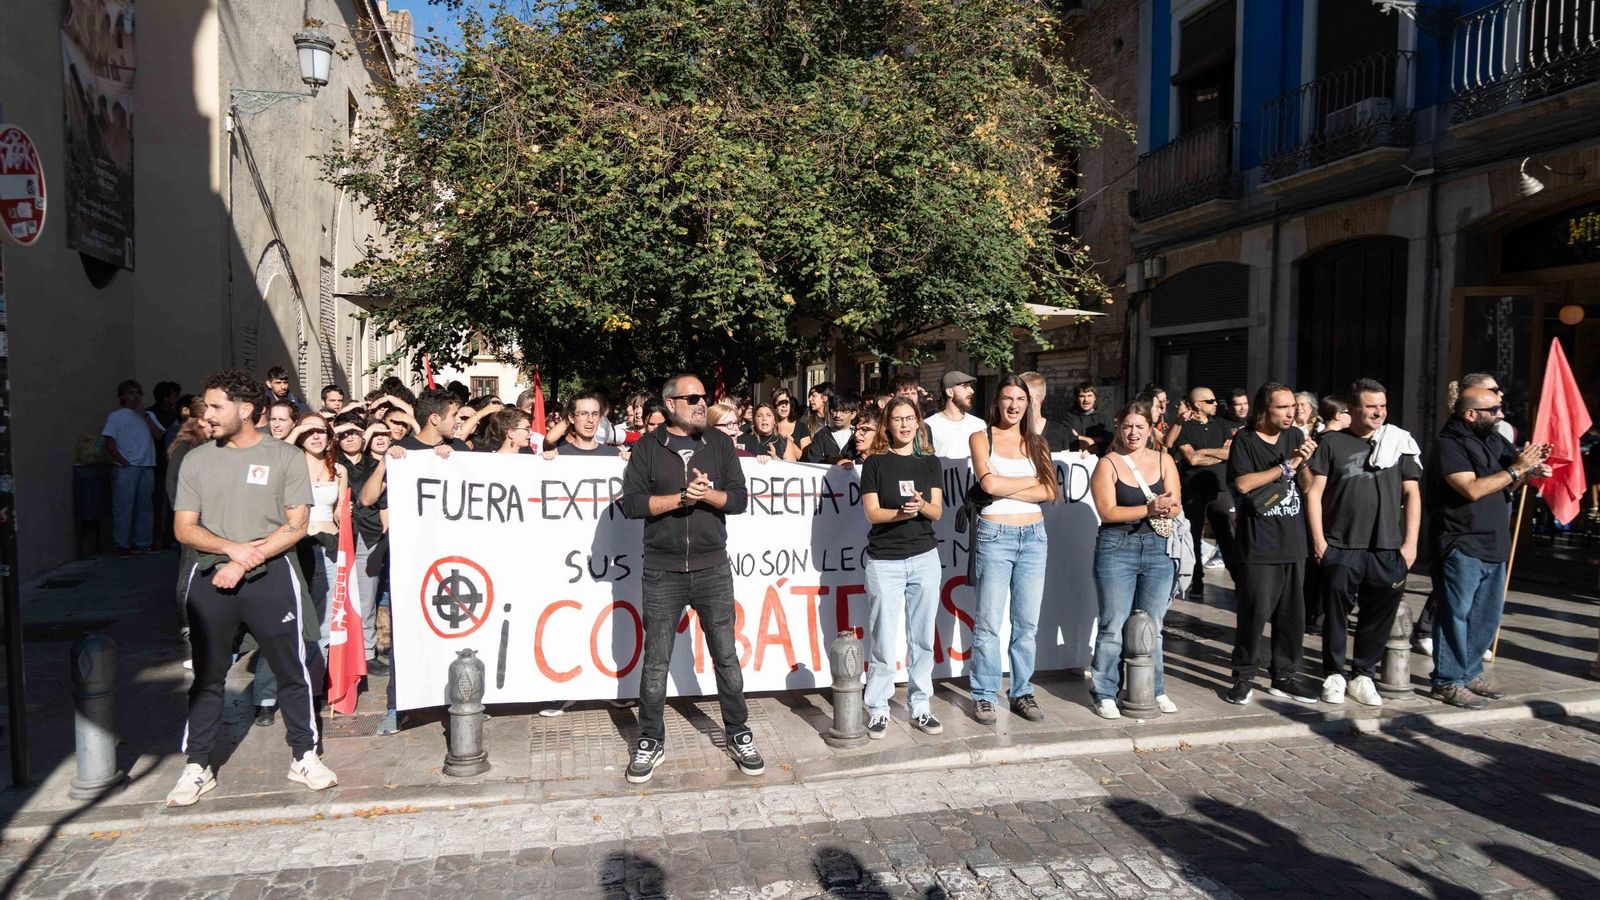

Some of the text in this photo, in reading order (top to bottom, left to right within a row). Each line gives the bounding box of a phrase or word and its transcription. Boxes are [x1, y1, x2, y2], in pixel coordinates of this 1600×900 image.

[417, 477, 524, 523] FUERA
[541, 476, 626, 520] EXTR
[750, 475, 840, 516] RECHA
[565, 550, 631, 584] SUS
[728, 553, 755, 577] NO
[760, 549, 808, 576] SON
